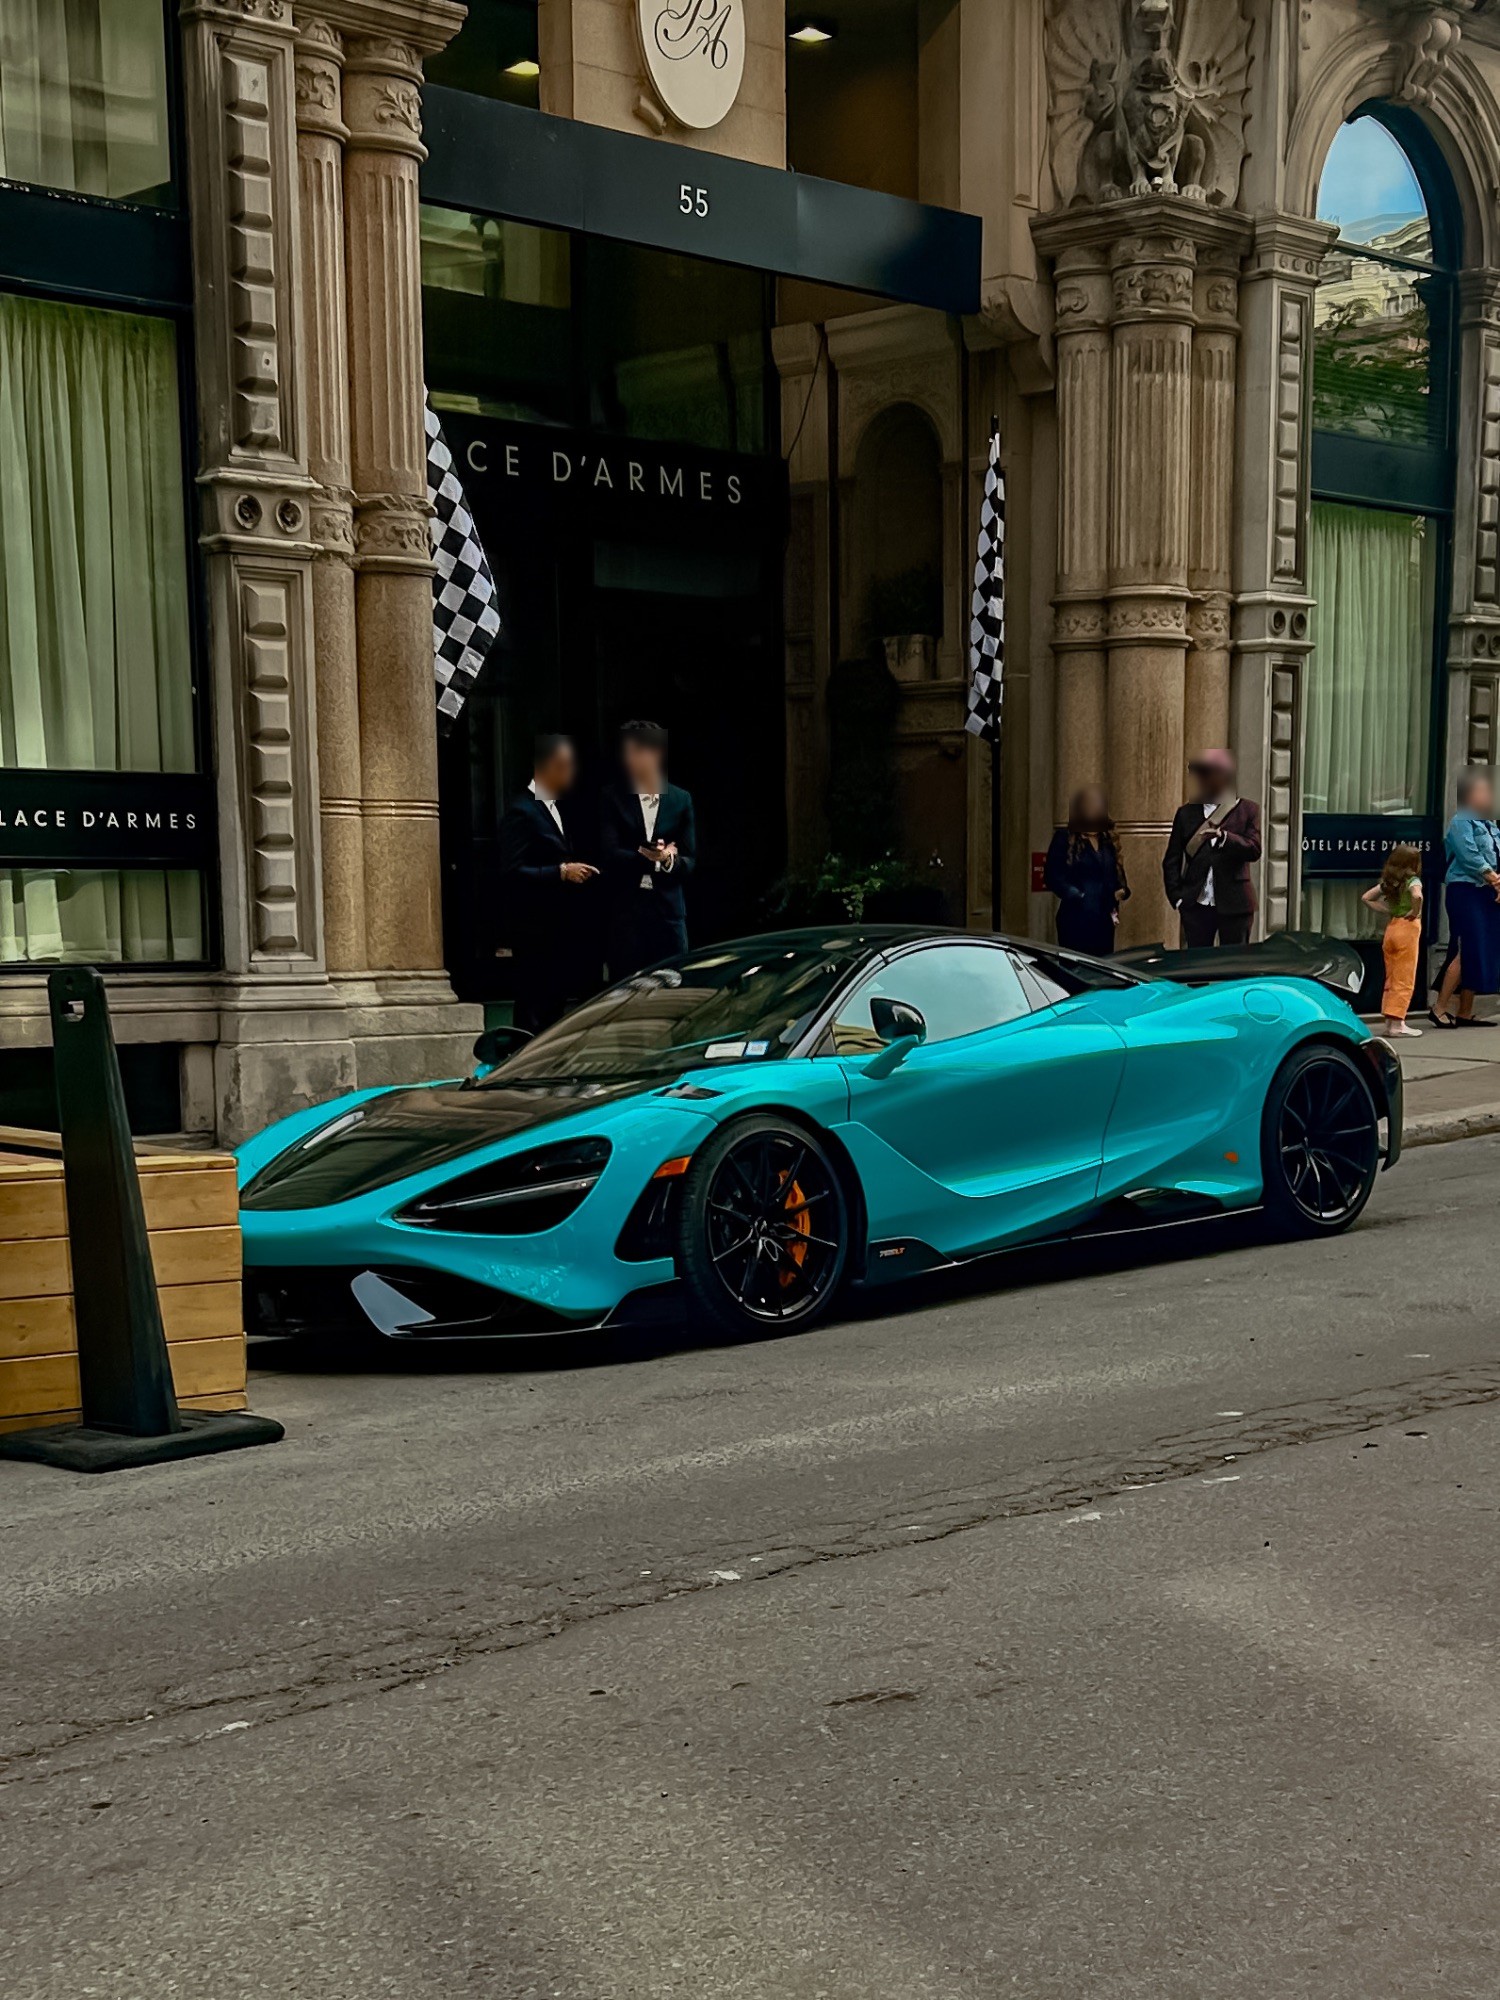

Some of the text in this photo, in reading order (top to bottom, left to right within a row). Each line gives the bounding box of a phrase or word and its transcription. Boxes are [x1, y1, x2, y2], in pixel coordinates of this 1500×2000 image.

[679, 184, 709, 218] 55
[552, 451, 742, 504] D'ARMES
[0, 809, 197, 829] LACE D'ARMES
[1301, 836, 1332, 852] ÔTEL
[1338, 840, 1376, 852] PLACE
